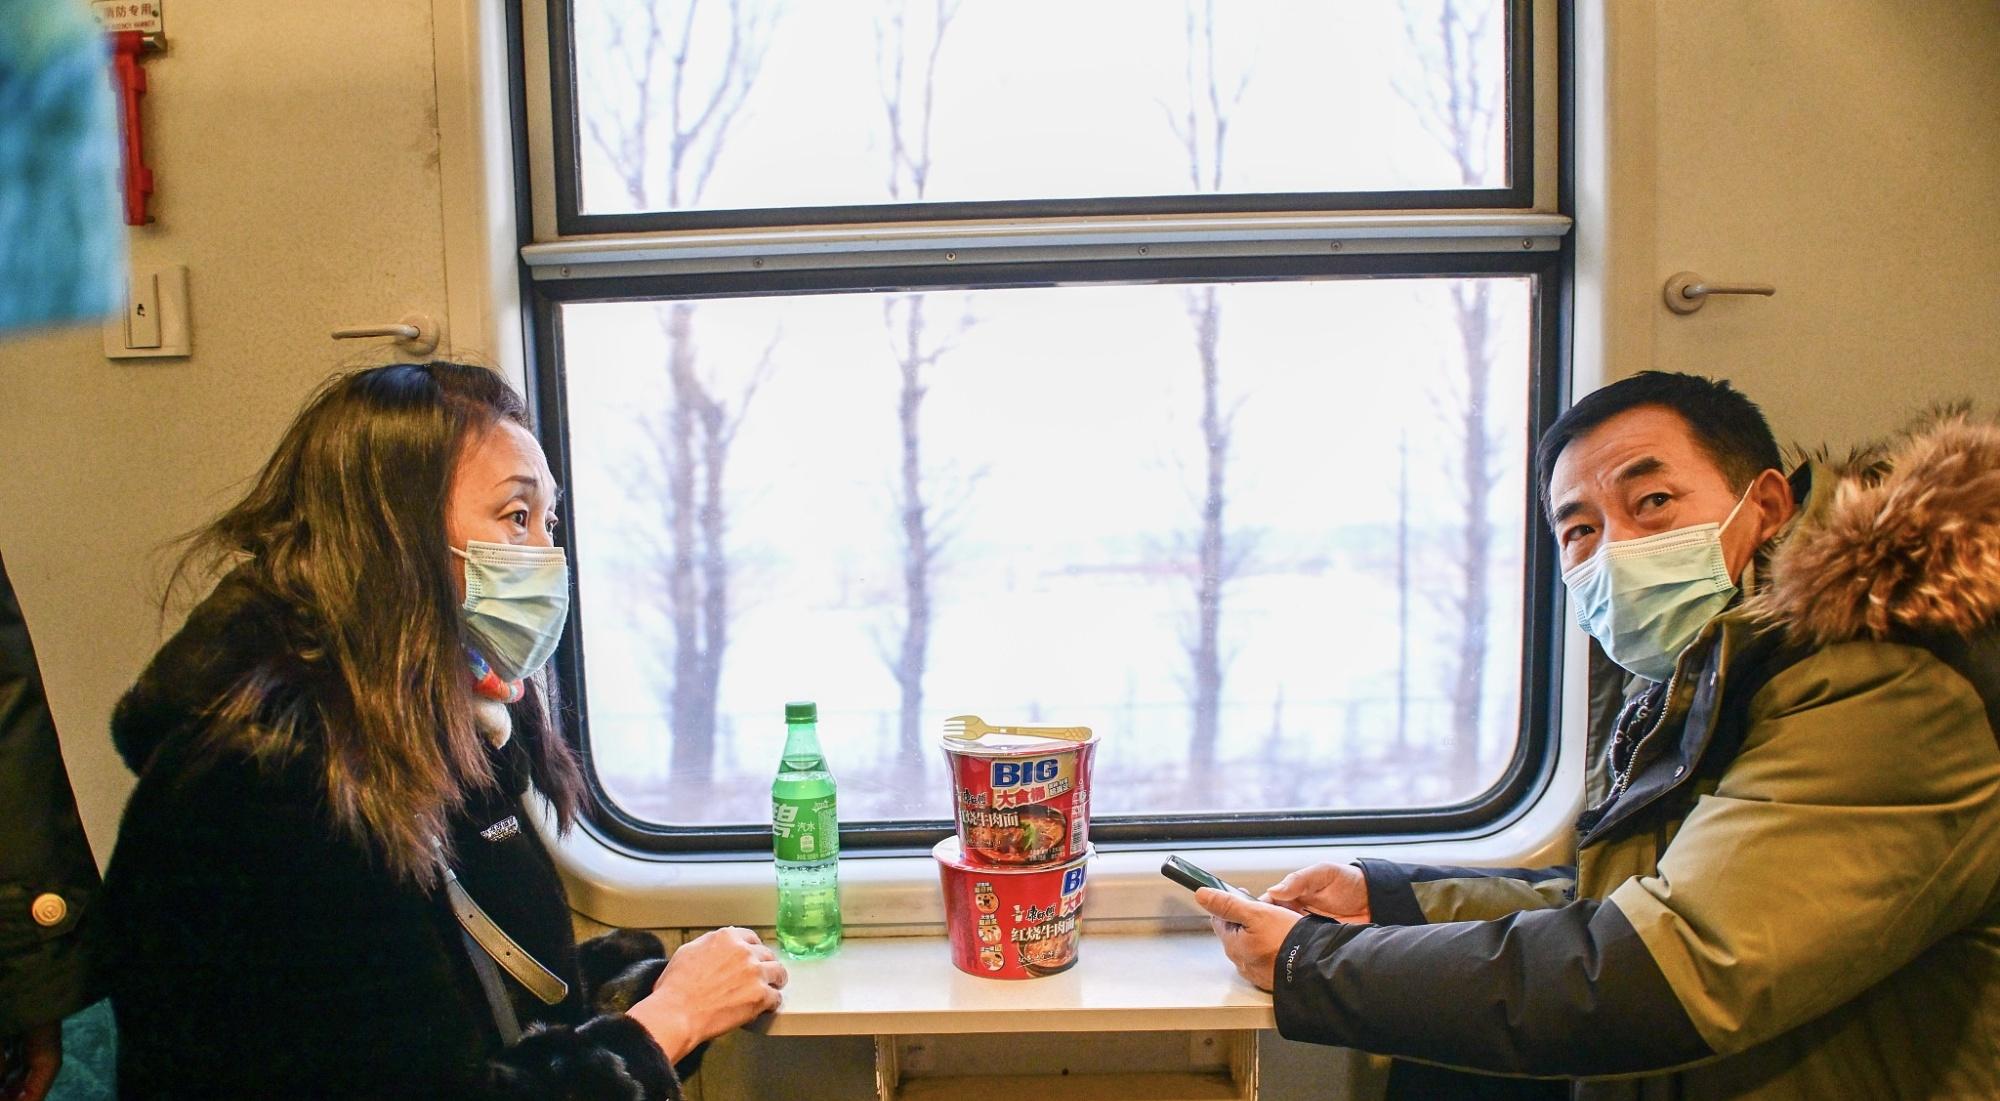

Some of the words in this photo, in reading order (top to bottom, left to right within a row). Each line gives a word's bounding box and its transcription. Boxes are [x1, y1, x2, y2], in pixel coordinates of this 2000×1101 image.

[993, 759, 1058, 787] BIG
[996, 786, 1046, 808] 大食桶
[797, 821, 816, 832] 汽水
[1026, 904, 1056, 923] 康师傅
[1011, 917, 1076, 943] 红烧牛肉面
[1286, 945, 1300, 982] TOREAD
